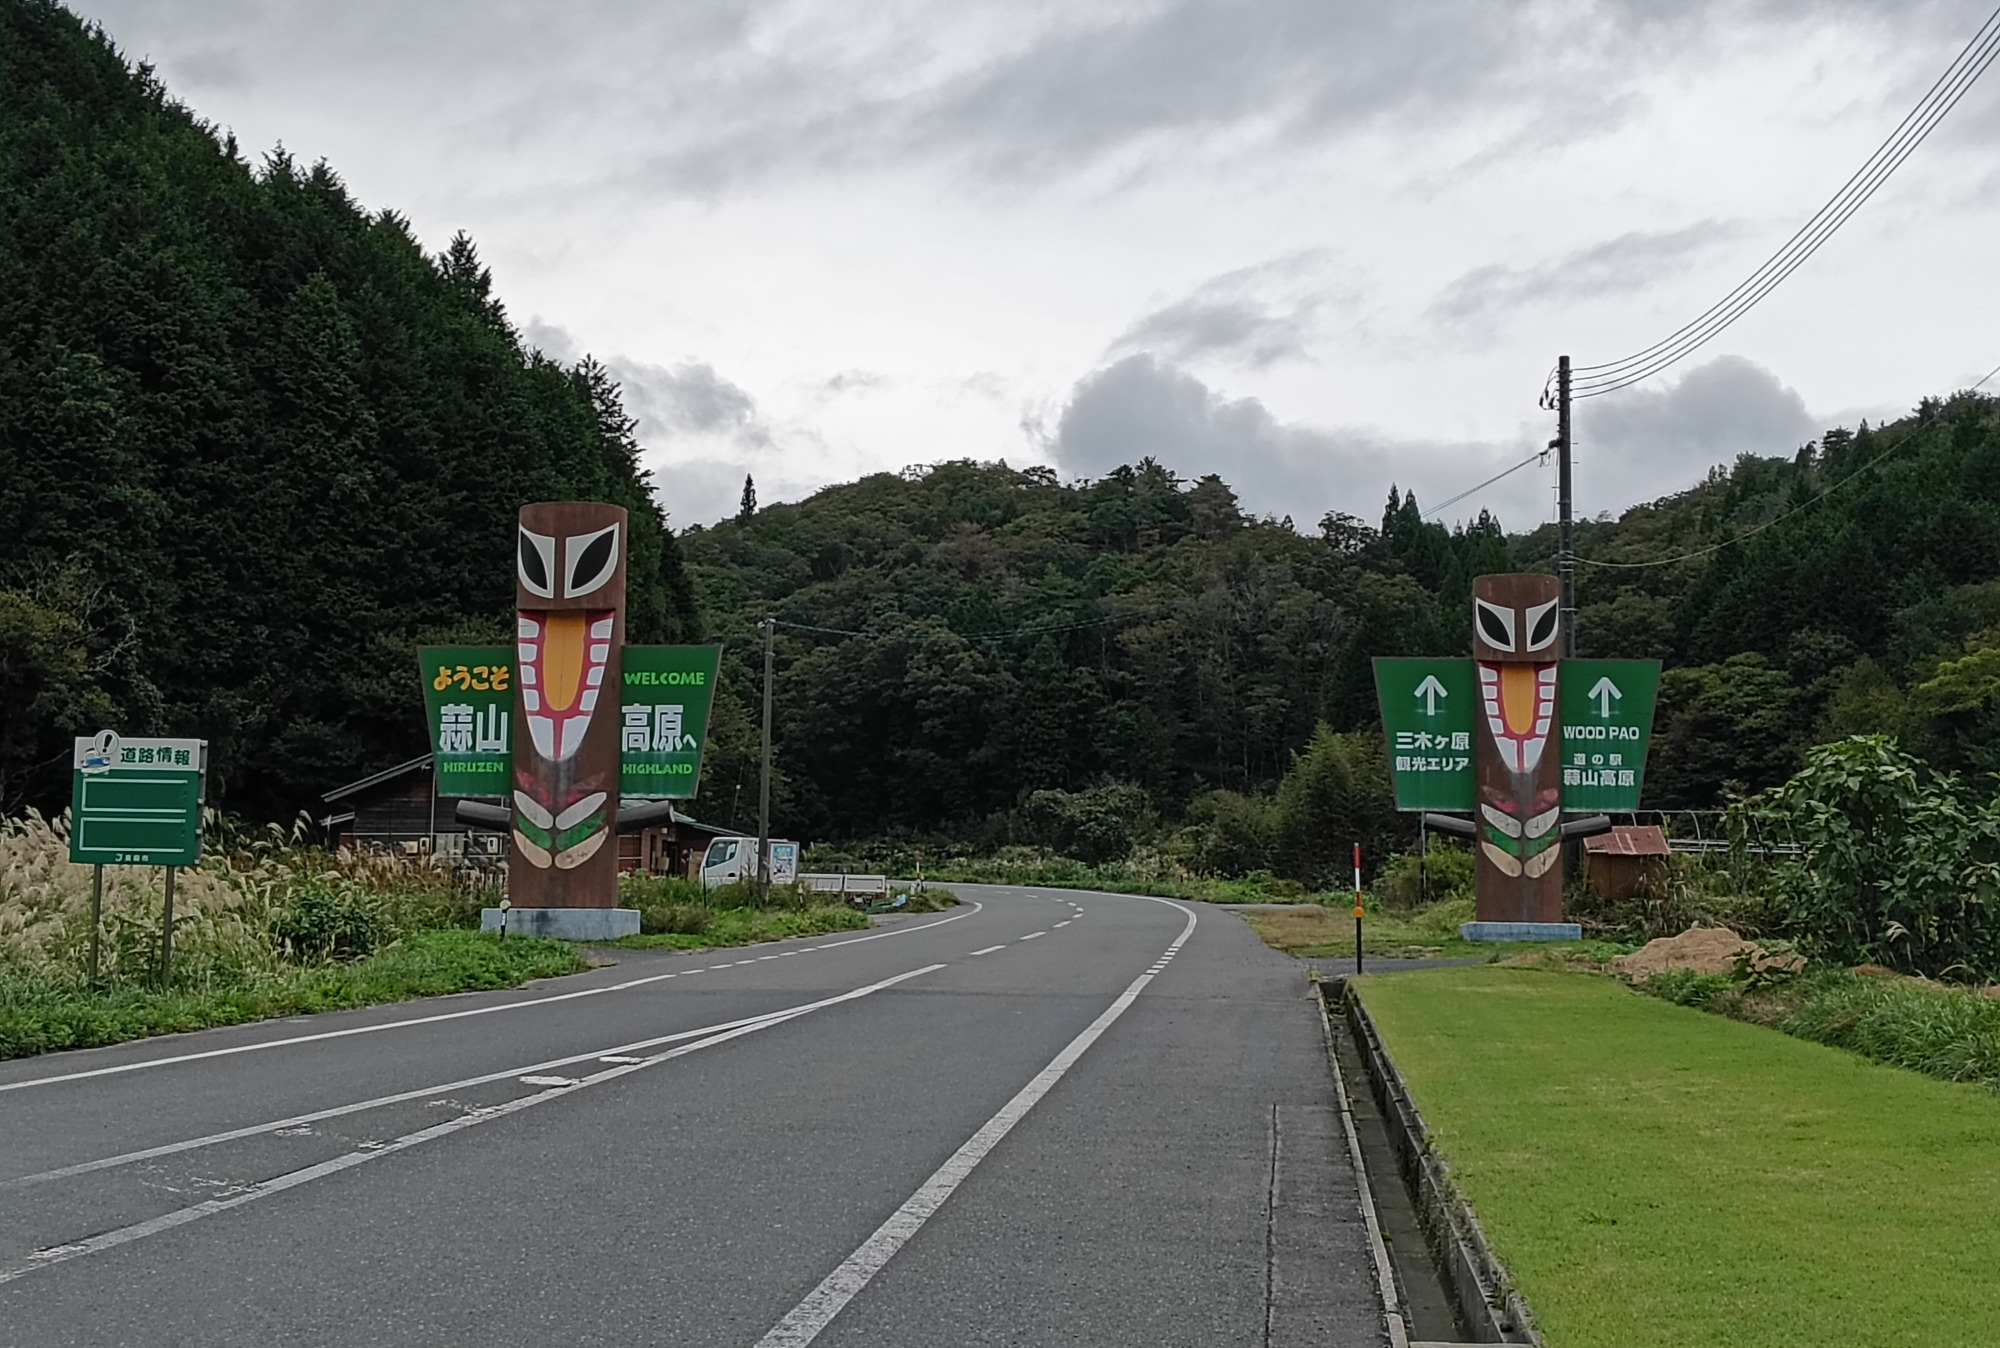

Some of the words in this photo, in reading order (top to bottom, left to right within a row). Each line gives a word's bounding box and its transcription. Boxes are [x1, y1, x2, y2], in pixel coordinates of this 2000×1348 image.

[433, 665, 510, 691] ようこそ
[624, 671, 705, 686] WELCOME
[439, 703, 509, 753] 蒜山
[621, 703, 697, 752] 高原へ
[1563, 725, 1606, 740] WOOD
[1609, 725, 1640, 740] PAO
[120, 746, 190, 766] 道路情報
[1395, 755, 1470, 771] 観光エリア
[443, 761, 504, 773] HIRUZEN
[622, 763, 693, 775] HIGHLAND
[1563, 768, 1635, 787] 蒜山高原
